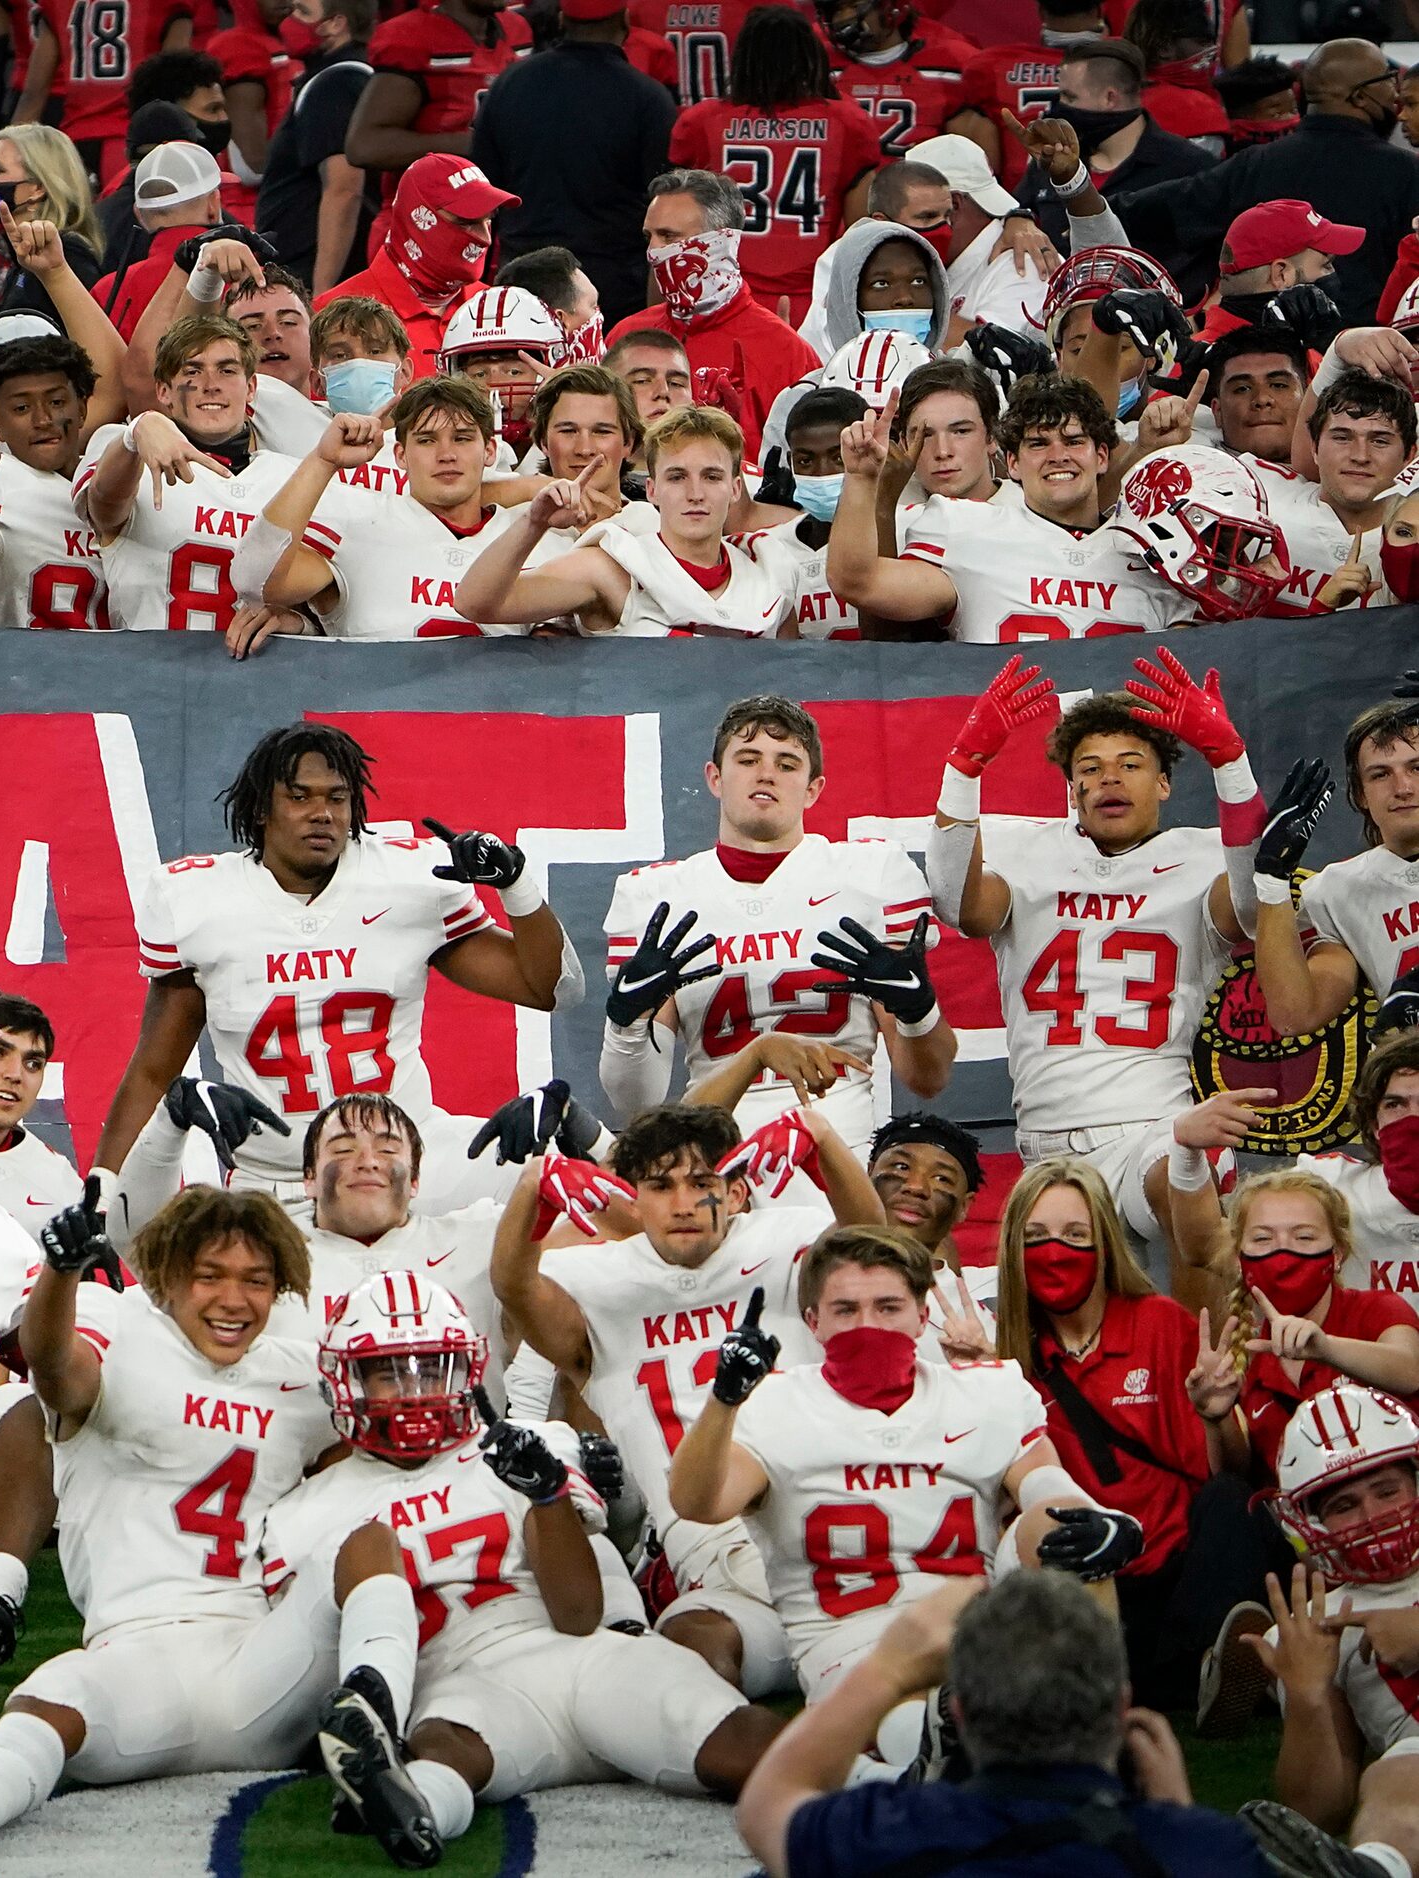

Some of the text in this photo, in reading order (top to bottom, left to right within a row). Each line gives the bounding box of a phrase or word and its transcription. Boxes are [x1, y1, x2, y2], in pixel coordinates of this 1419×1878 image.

[666, 4, 722, 28] LOWE
[68, 0, 129, 81] 18
[666, 31, 730, 107] 10
[723, 118, 829, 140] JACKSON
[722, 144, 828, 237] 34
[472, 328, 507, 338] Riddell
[195, 506, 256, 538] KAT
[64, 530, 102, 560] KA
[411, 576, 457, 607] KA
[798, 591, 848, 623] ATY
[1030, 577, 1118, 610] KATY
[1057, 891, 1147, 921] KATY
[266, 947, 357, 983] KATY
[715, 928, 803, 966] KATY
[1020, 926, 1182, 1052] 43
[701, 968, 853, 1084] 42
[244, 988, 399, 1115] 48
[643, 1301, 737, 1349] KATY
[183, 1393, 274, 1439] KATY
[844, 1463, 944, 1490] KATY
[170, 1444, 258, 1582] 4
[391, 1484, 451, 1529] ATY
[802, 1494, 987, 1621] 84
